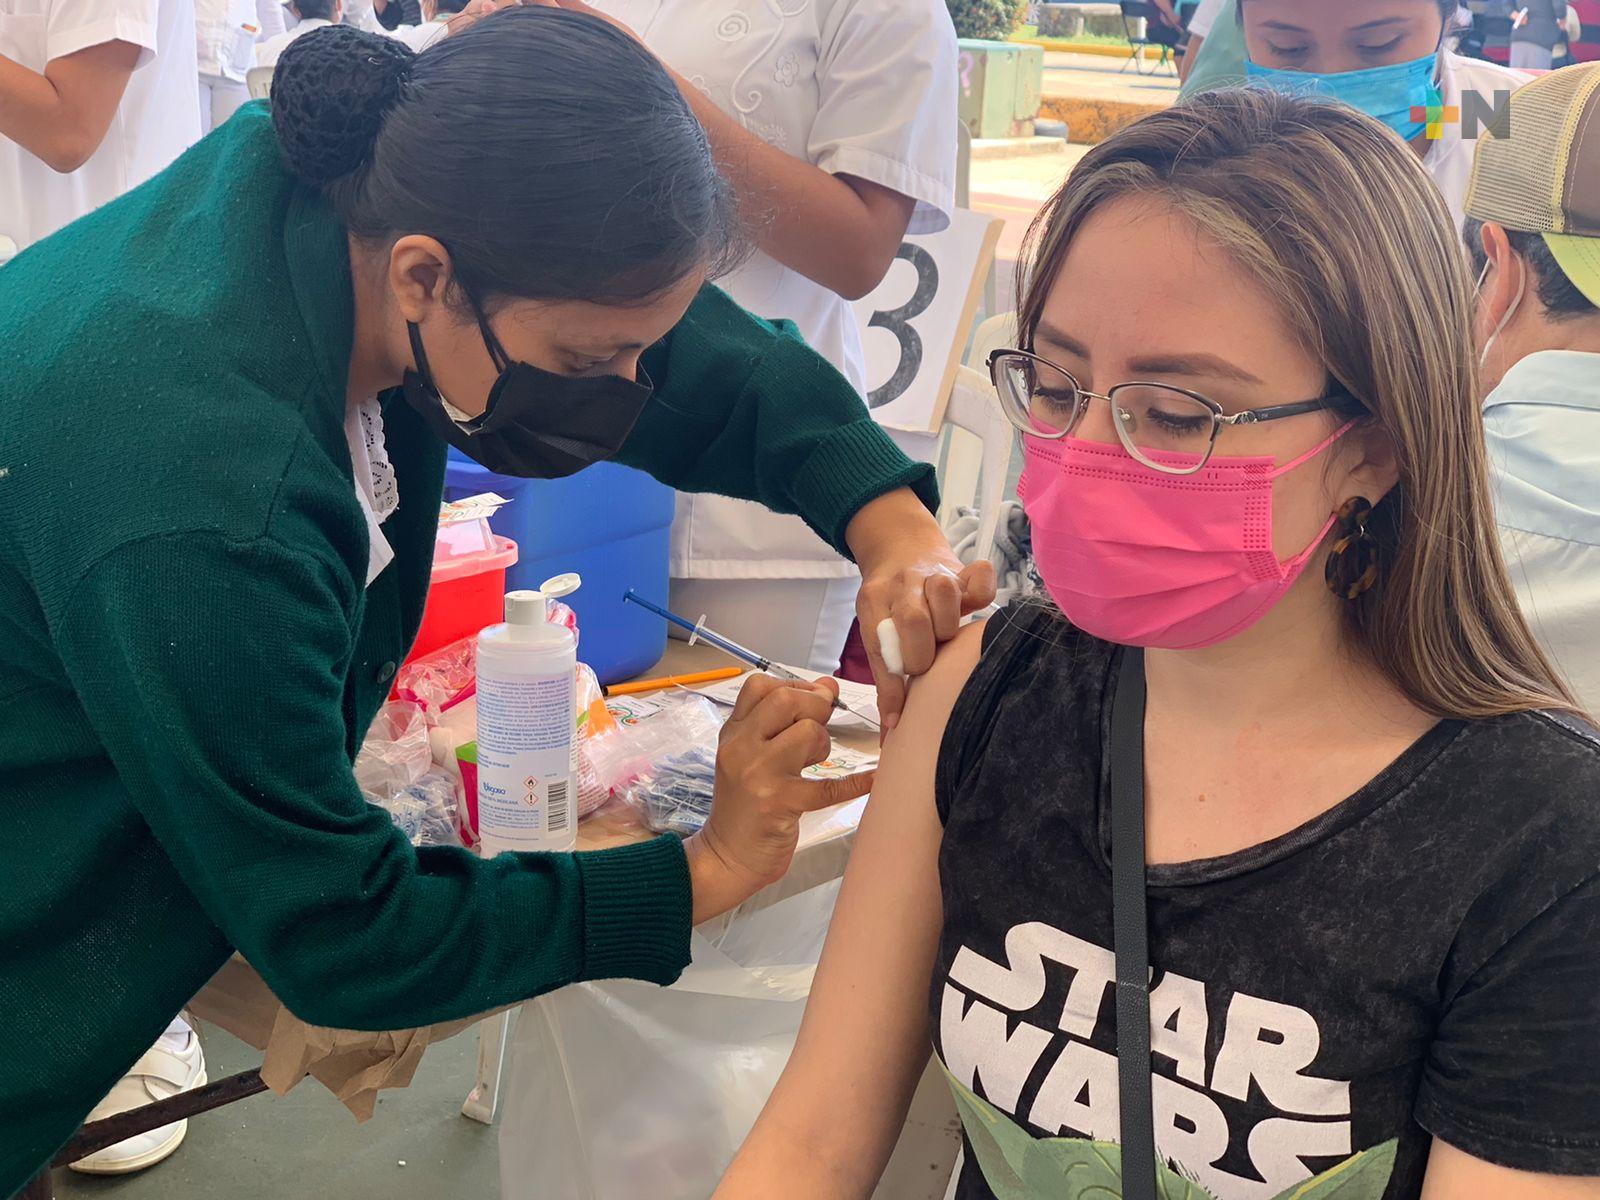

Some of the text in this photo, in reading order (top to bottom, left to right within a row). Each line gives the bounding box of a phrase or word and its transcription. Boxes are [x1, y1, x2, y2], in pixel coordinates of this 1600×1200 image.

[867, 242, 939, 409] 3
[939, 982, 1352, 1200] WARS
[948, 920, 1351, 1115] STAR
